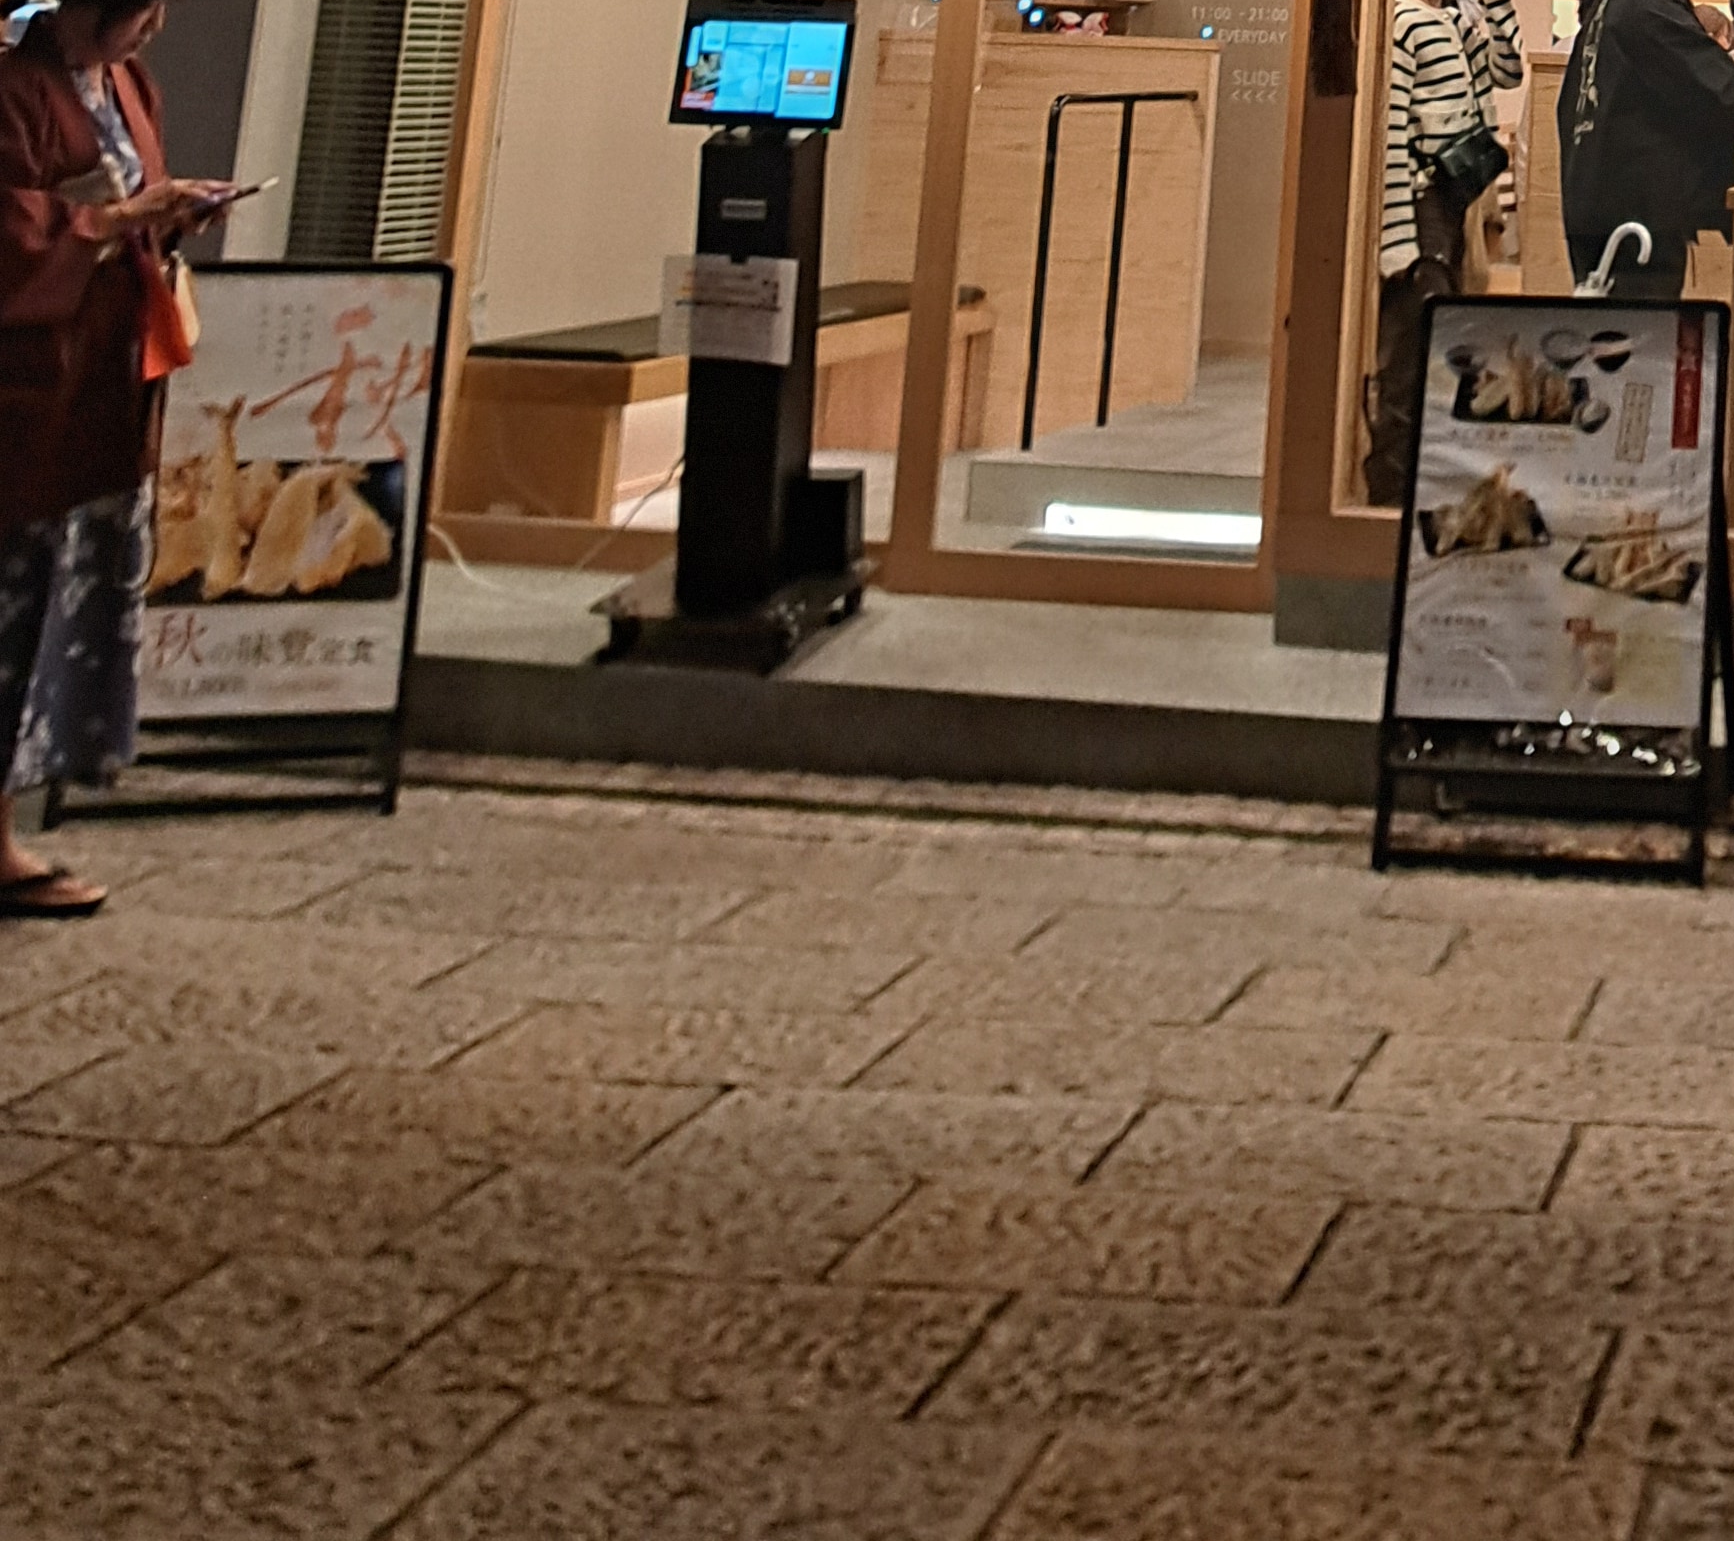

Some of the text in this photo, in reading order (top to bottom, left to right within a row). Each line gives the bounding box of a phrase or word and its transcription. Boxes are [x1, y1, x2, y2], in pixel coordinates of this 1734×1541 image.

[1192, 6, 1231, 20] 11:00
[1248, 7, 1289, 22] 21:00
[1218, 28, 1287, 43] EVERYDAY
[1232, 69, 1280, 86] SLIDE
